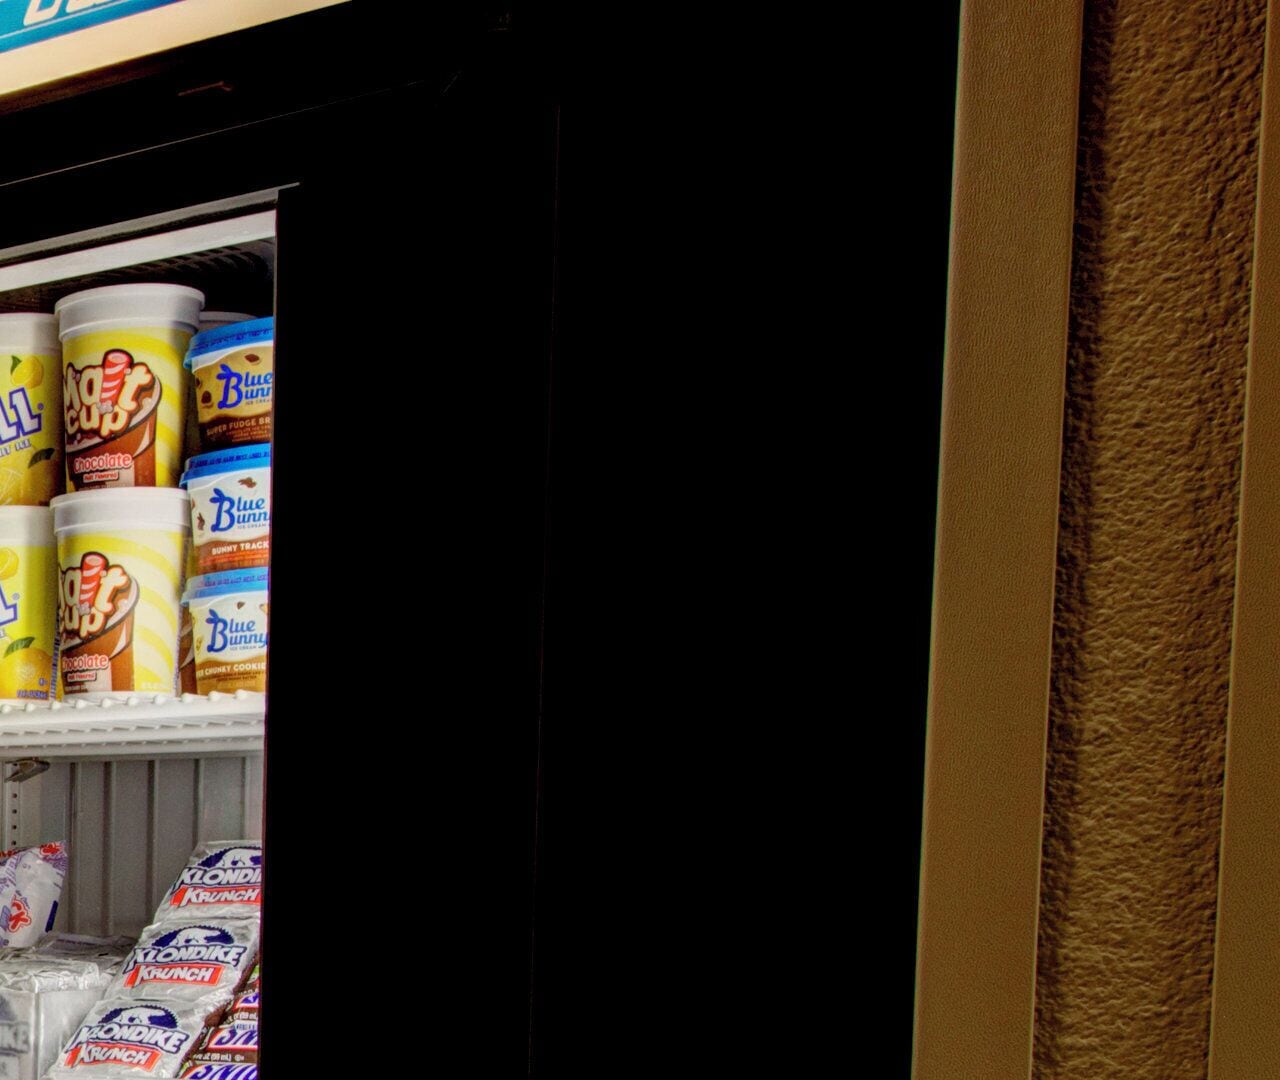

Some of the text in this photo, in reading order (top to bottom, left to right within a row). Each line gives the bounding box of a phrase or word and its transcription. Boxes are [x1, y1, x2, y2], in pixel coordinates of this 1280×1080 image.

[229, 418, 257, 429] FUDGE
[73, 453, 132, 474] Chocolate
[240, 540, 269, 551] TRACK
[174, 867, 261, 894] KLONDI
[185, 886, 260, 906] KRUNCH
[124, 945, 246, 973] KLONDIKE
[139, 964, 212, 982] KRUNCH
[64, 1025, 189, 1055] KLONDIKE
[75, 1044, 150, 1066] KRUNCH
